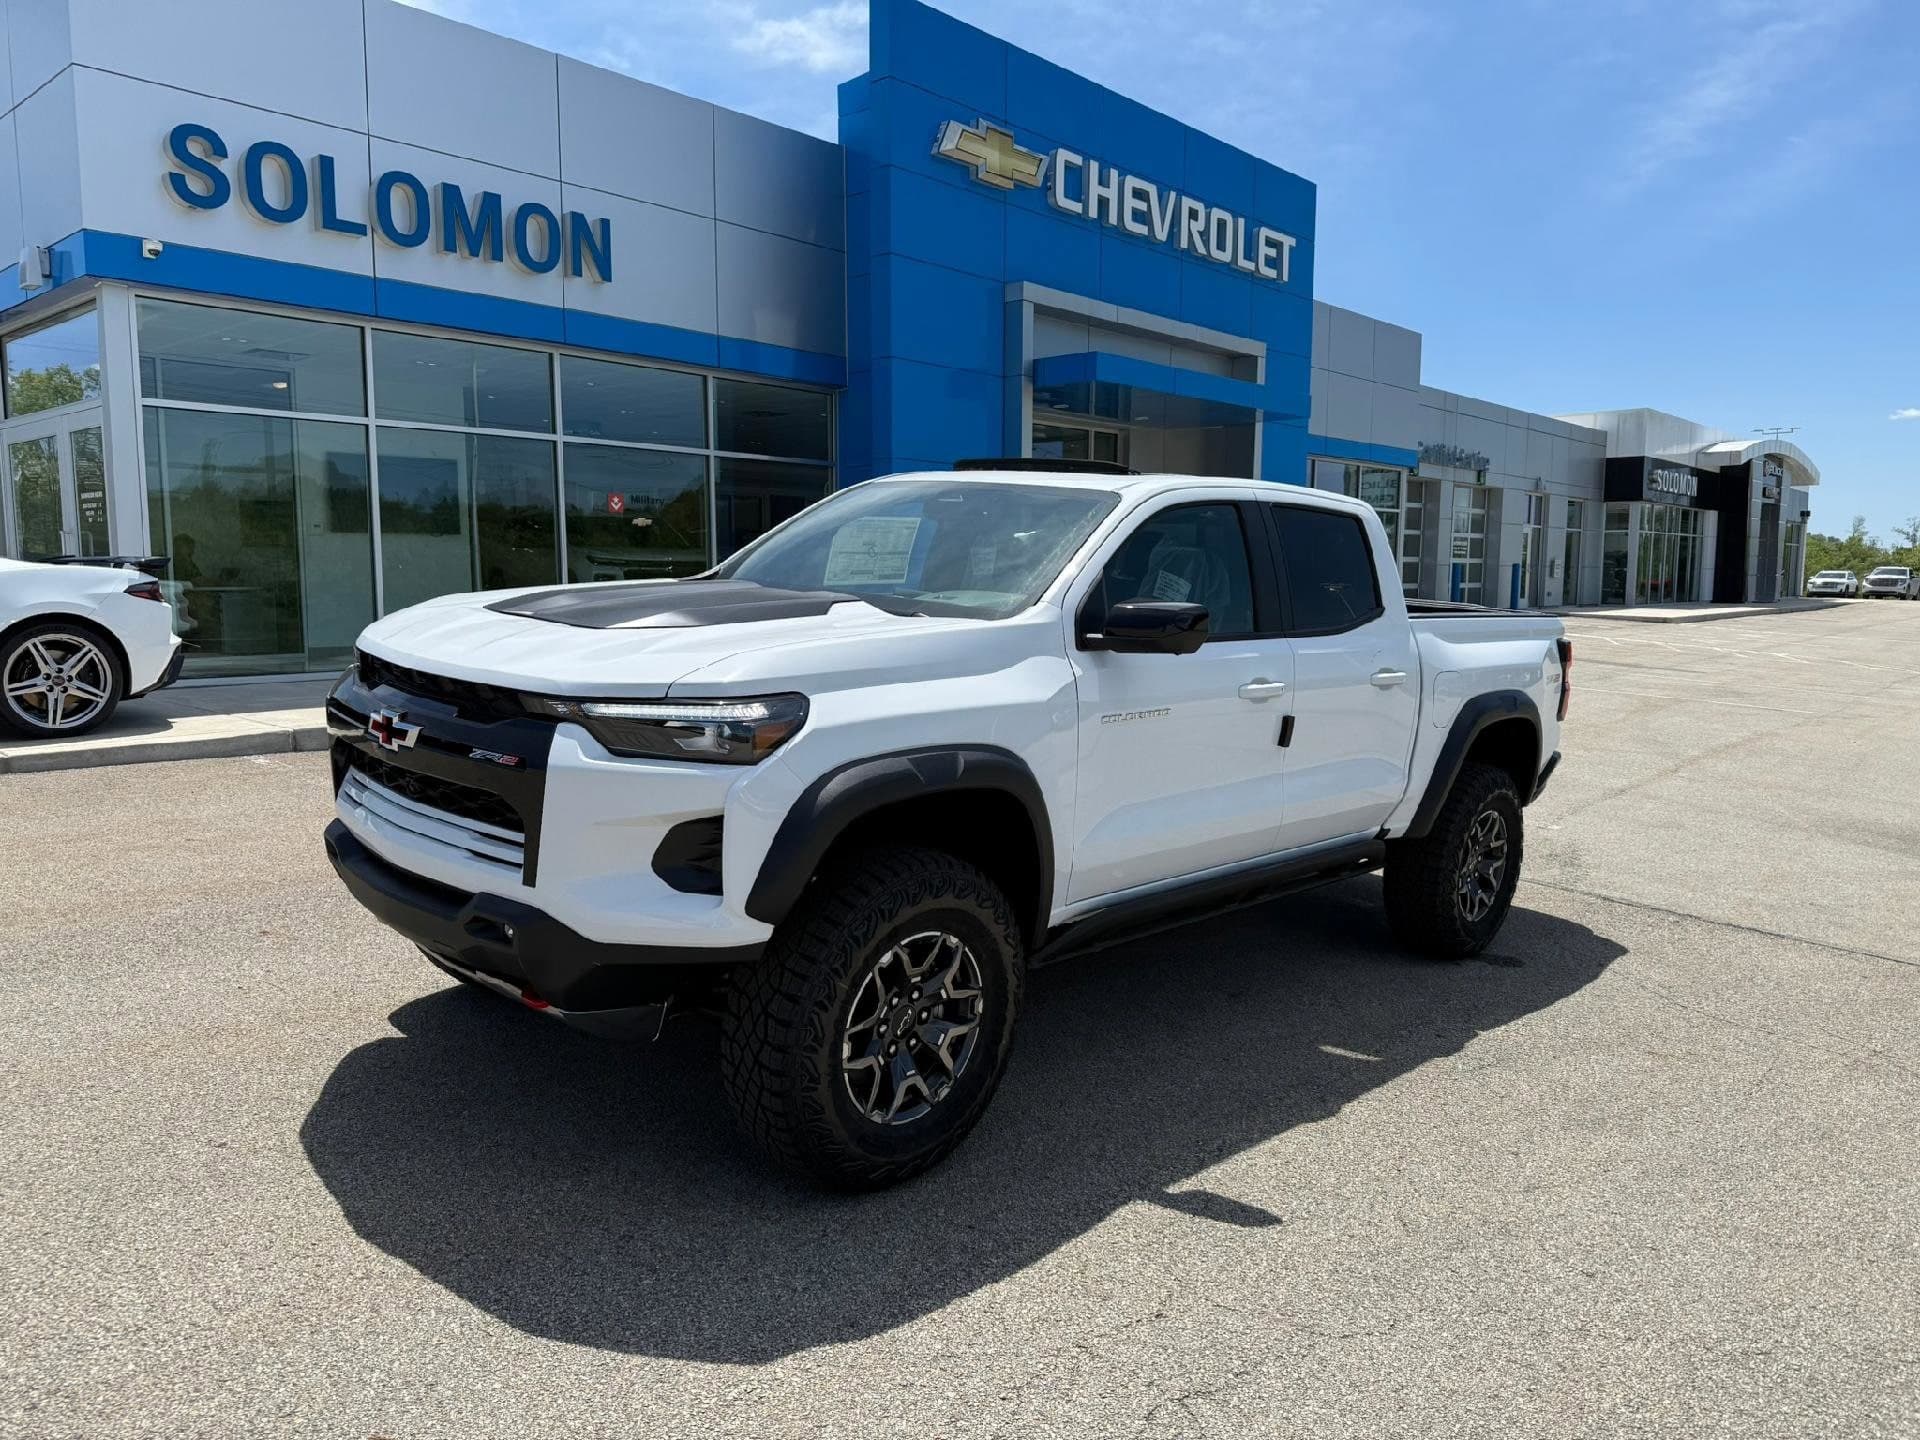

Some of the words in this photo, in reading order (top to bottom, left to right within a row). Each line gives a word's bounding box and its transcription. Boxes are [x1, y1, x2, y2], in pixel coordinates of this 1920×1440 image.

[163, 123, 613, 283] SOLOMON
[1051, 147, 1297, 283] CHEVROLET
[1657, 468, 1698, 497] SOLOMON
[630, 494, 665, 506] Military
[469, 747, 519, 766] ZR2
